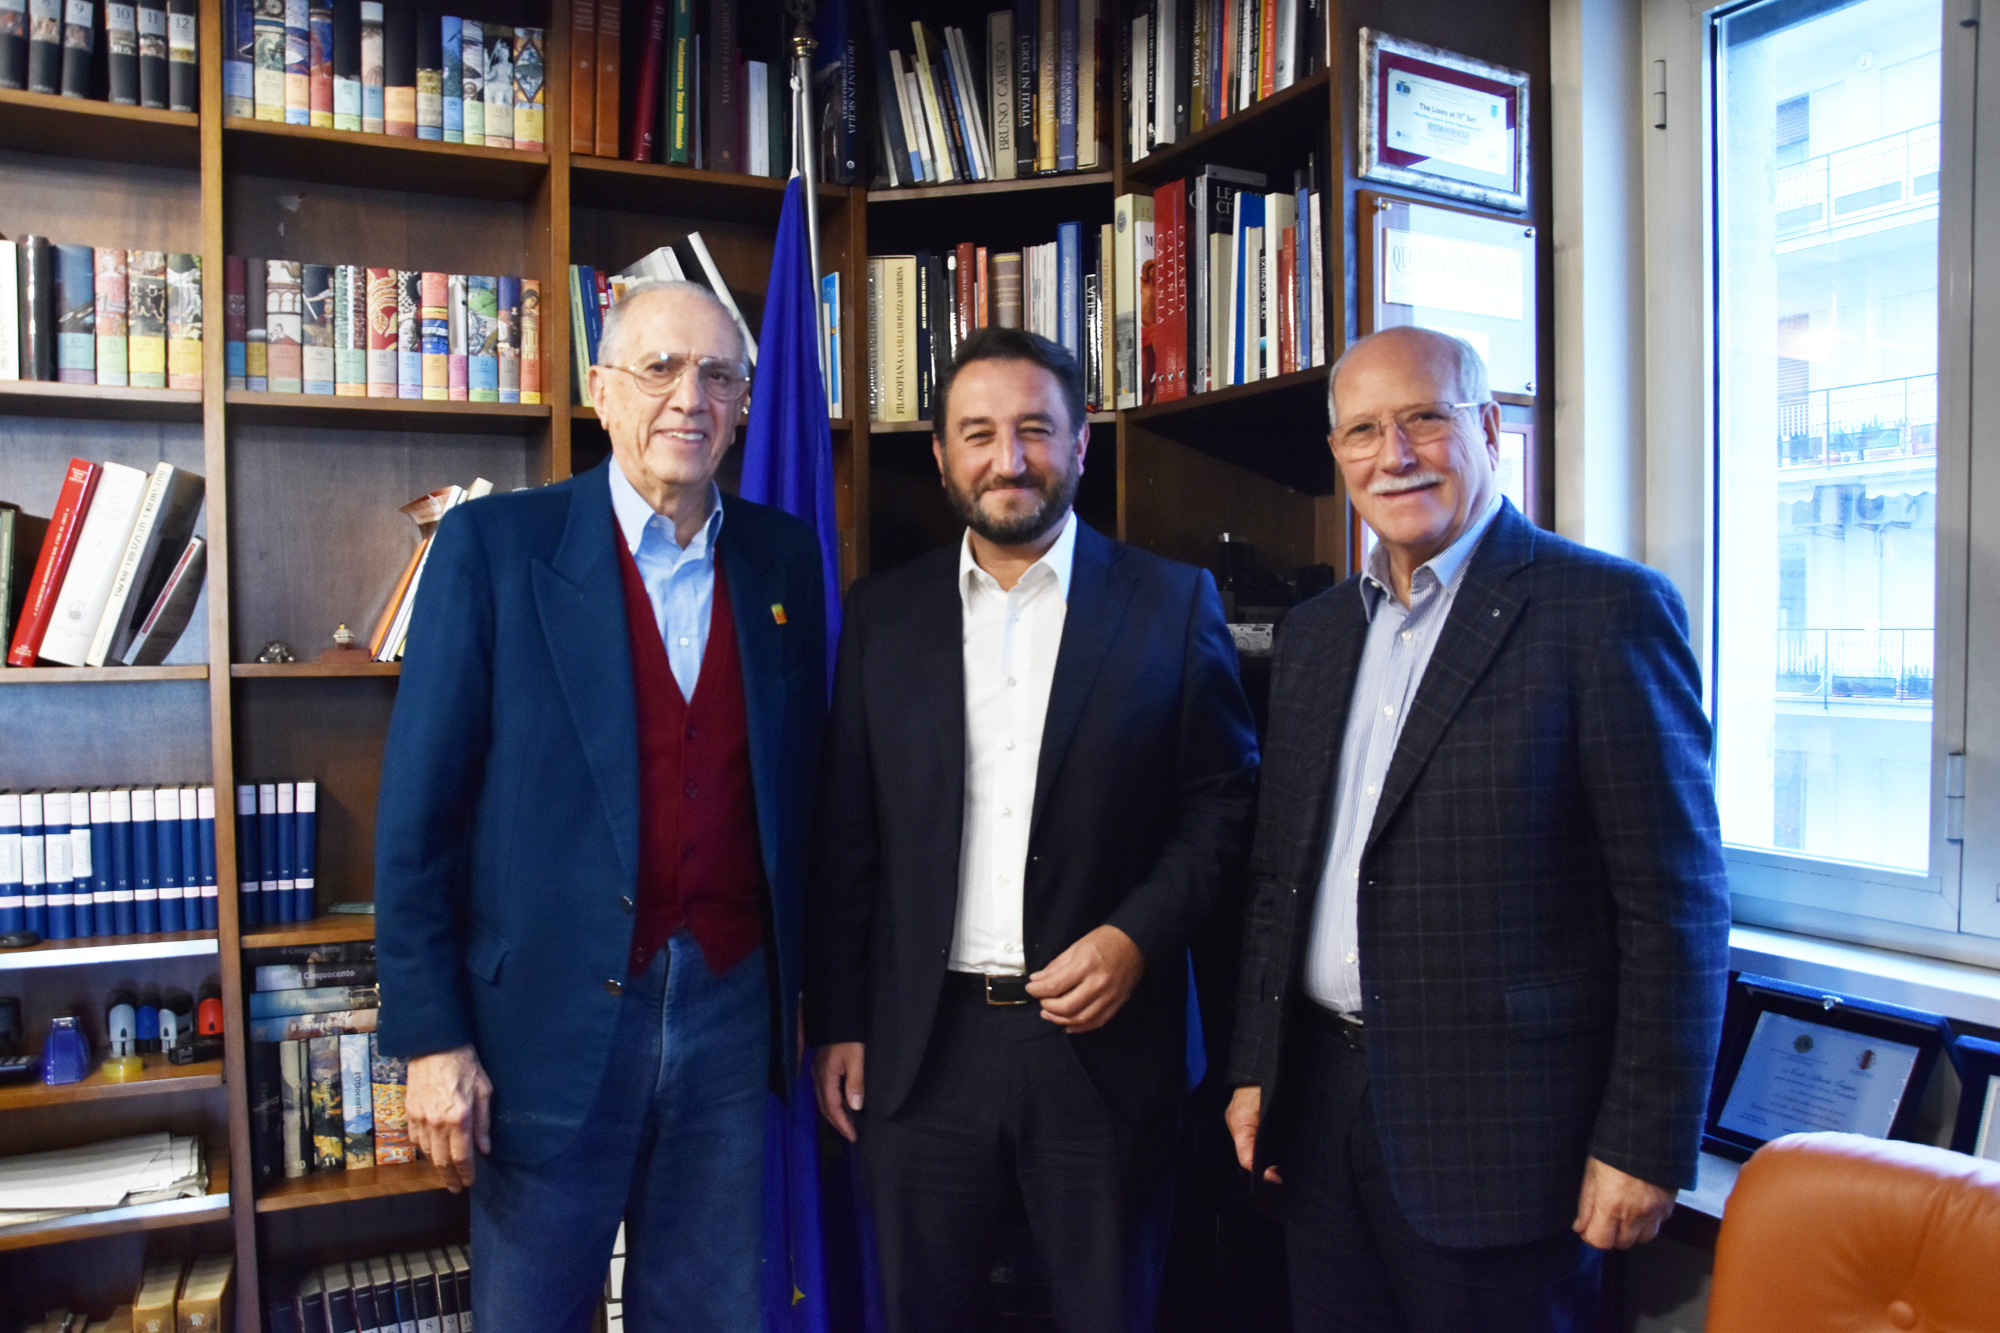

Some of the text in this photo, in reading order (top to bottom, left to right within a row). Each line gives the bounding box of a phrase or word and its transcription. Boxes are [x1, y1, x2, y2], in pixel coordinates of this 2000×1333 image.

[75, 3, 84, 14] 9
[116, 7, 130, 20] 10
[147, 12, 158, 24] 11
[176, 17, 189, 30] 12
[1193, 36, 1201, 46] di
[1022, 42, 1030, 73] GRECI
[1193, 49, 1202, 76] porto
[848, 45, 856, 86] ROMANI
[1022, 77, 1030, 89] IN
[1046, 32, 1054, 124] BISANZIO IN SICILIA
[676, 38, 686, 150] Fontanarossa Terzo Millennio
[848, 88, 856, 98] IN
[996, 42, 1010, 151] BRUNO CARUSO
[1022, 92, 1031, 127] ITALIA
[1419, 102, 1430, 112] The
[1432, 105, 1448, 117] Lions
[1449, 110, 1456, 118] at
[848, 100, 857, 134] SICILIA
[1216, 186, 1232, 200] LE
[1392, 245, 1517, 284] QUOTIDIANO DI SICILIA
[896, 266, 904, 298] ARMERINA
[1103, 290, 1109, 298] DI
[896, 300, 904, 321] PIAZZA
[1087, 285, 1096, 327] SICILIA
[896, 330, 904, 348] VILLA
[896, 349, 904, 358] LA
[896, 359, 904, 414] FILOSOFIANA
[142, 470, 166, 518] DALL'AMERICA
[296, 969, 355, 980] il Cinquecento
[354, 1072, 362, 1114] l'Ottocento
[356, 1153, 366, 1162] 12
[392, 1150, 402, 1158] 13
[293, 1160, 306, 1170] 10
[324, 1157, 336, 1166] 11
[264, 1165, 270, 1174] 9
[426, 1320, 432, 1330] 8
[448, 1316, 454, 1326] 9
